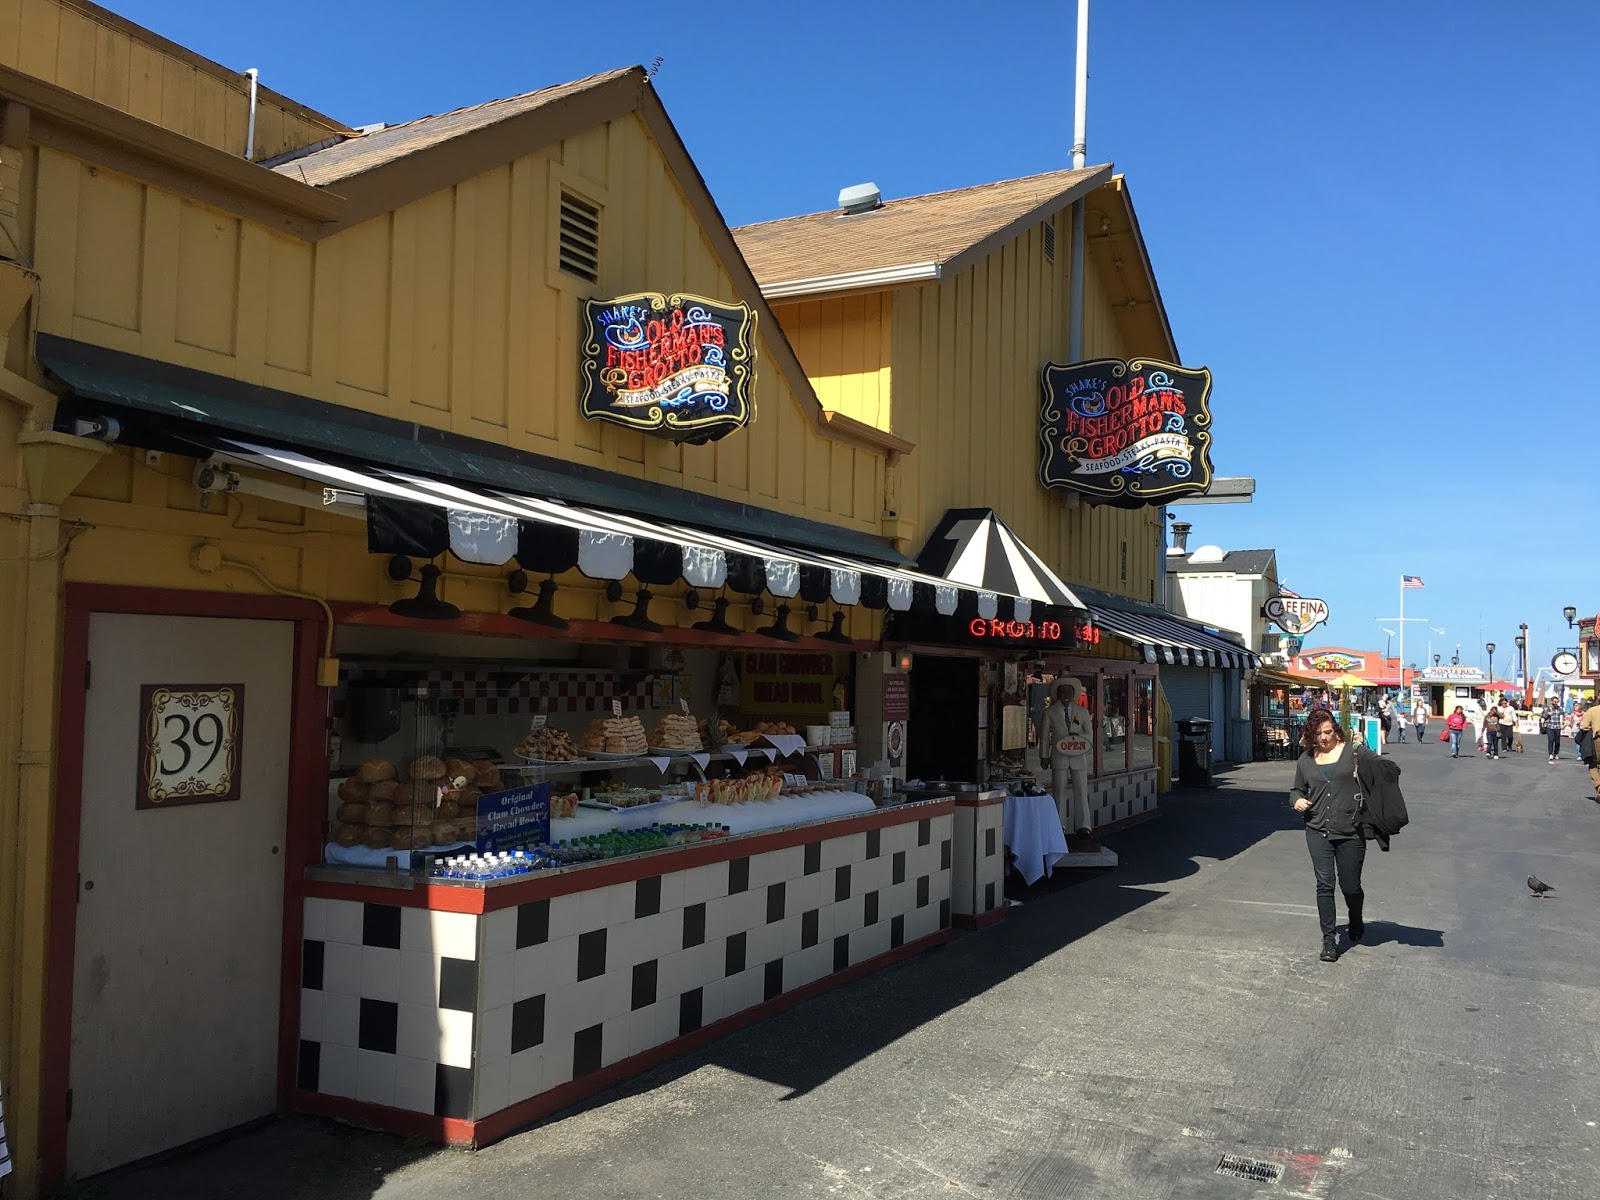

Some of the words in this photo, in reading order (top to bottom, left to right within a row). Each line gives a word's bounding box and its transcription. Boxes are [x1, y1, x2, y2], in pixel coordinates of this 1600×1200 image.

[597, 305, 650, 326] SHAKE'S
[646, 308, 684, 344] OLD
[606, 324, 725, 370] FISHERMAN'S
[627, 345, 702, 391] GROTTO
[1065, 378, 1107, 398] SHAKE'S
[1106, 376, 1145, 409] OLD
[1065, 391, 1187, 438] FISHERMAN'S
[1088, 411, 1163, 459] GROTTO
[1268, 600, 1297, 617] CAFE
[1300, 601, 1325, 618] FINA
[160, 712, 224, 776] 39
[1060, 741, 1087, 751] OPEN
[487, 810, 509, 821] Clam
[510, 801, 545, 816] Chowder
[501, 790, 534, 806] Original
[493, 818, 518, 833] Bread
[519, 812, 539, 826] Bowl
